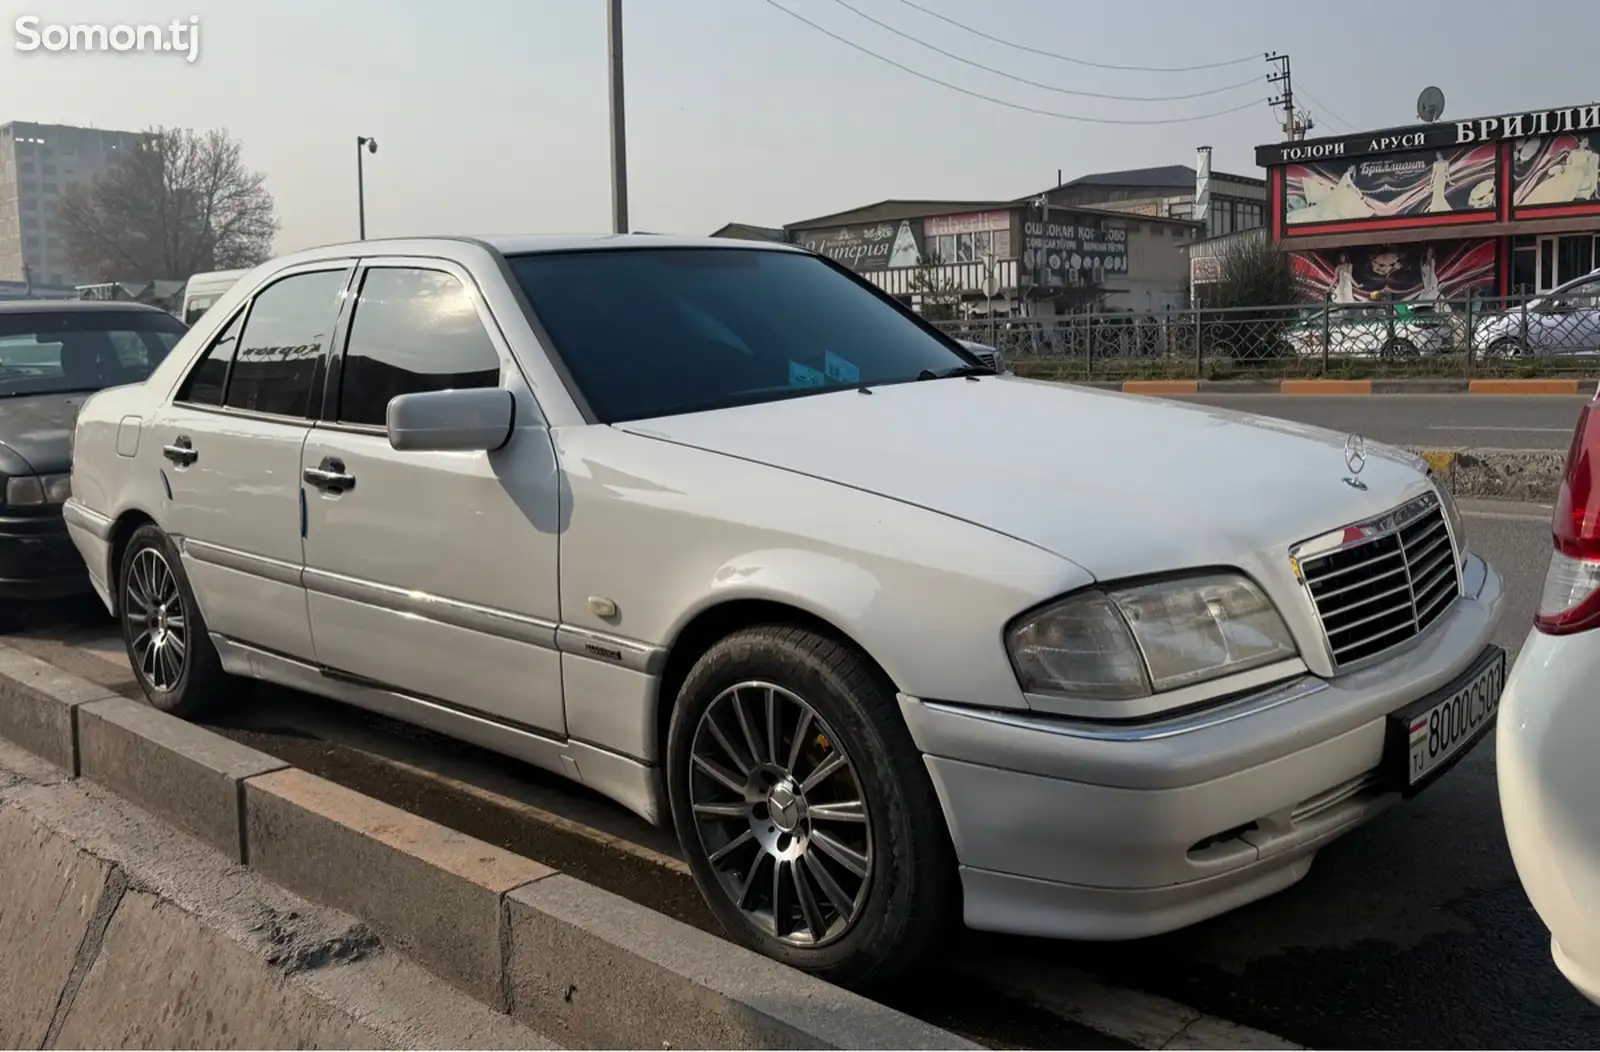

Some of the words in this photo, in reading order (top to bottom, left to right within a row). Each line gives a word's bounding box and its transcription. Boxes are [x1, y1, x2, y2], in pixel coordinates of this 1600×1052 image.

[1281, 142, 1345, 161] ТОЛОРИ
[1455, 105, 1600, 144] БРИЛЛИ
[931, 212, 999, 234] faberlic
[1412, 749, 1424, 774] TJ
